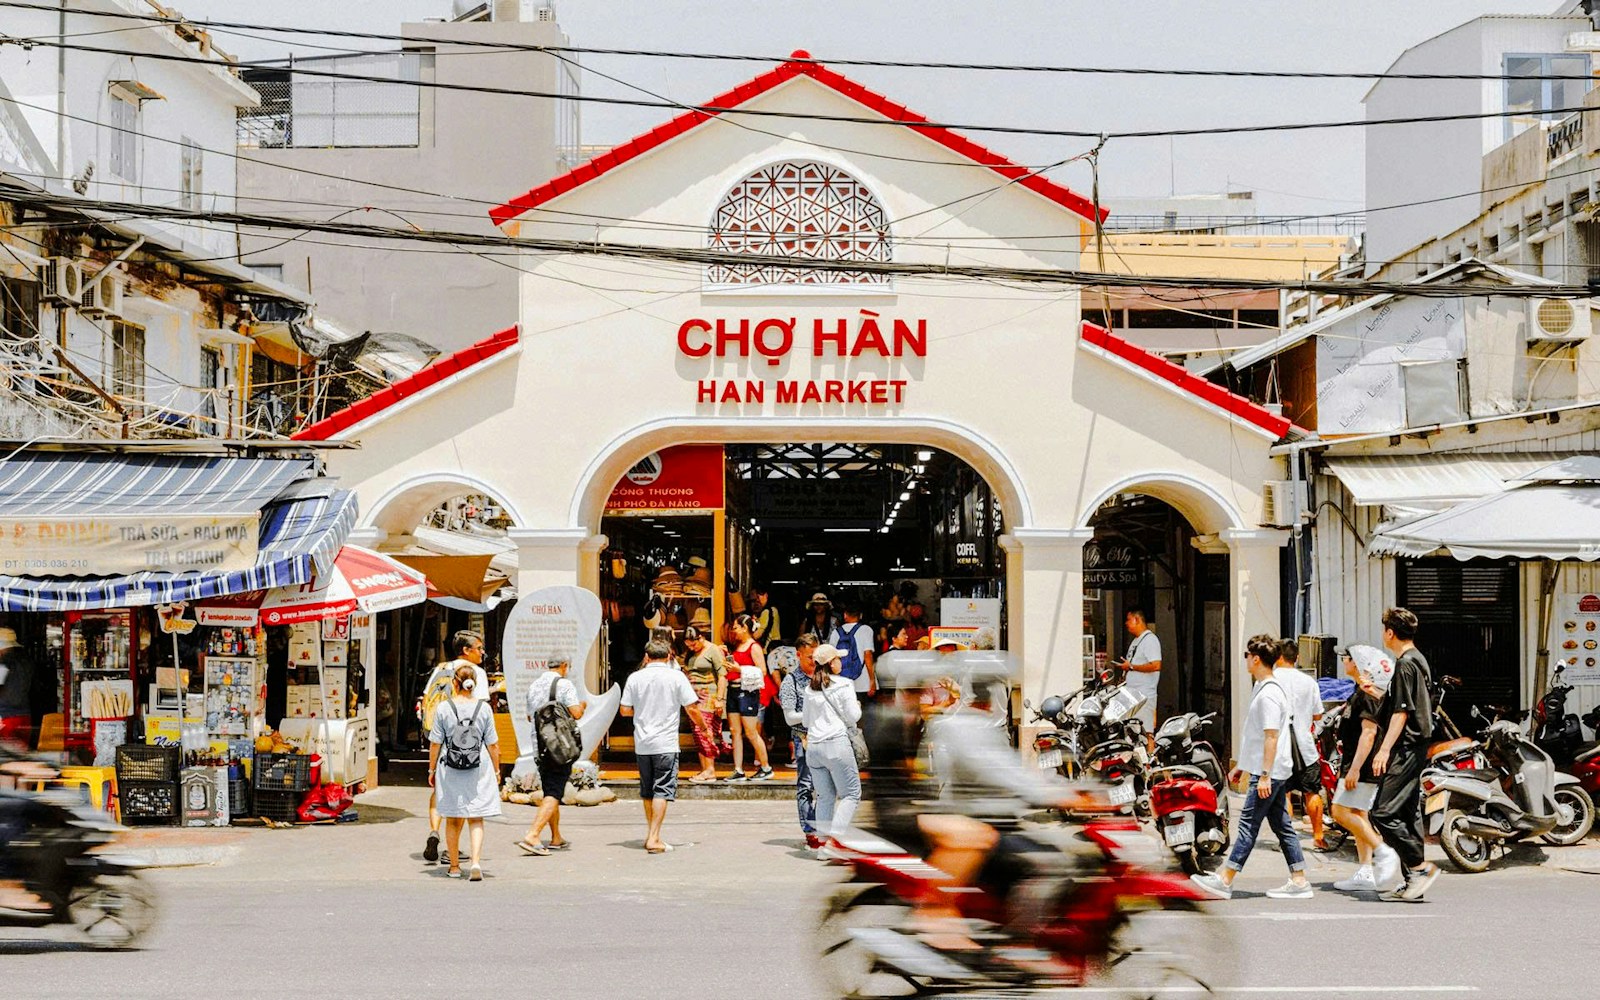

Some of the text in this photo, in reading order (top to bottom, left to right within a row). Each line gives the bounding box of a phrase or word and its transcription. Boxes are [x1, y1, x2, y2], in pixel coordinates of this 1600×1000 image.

[677, 308, 927, 366] CHỢ HÀN
[697, 380, 907, 404] HAN MARKET
[151, 520, 179, 541] SỮA
[175, 550, 224, 566] CHANH
[1119, 571, 1137, 584] Spa
